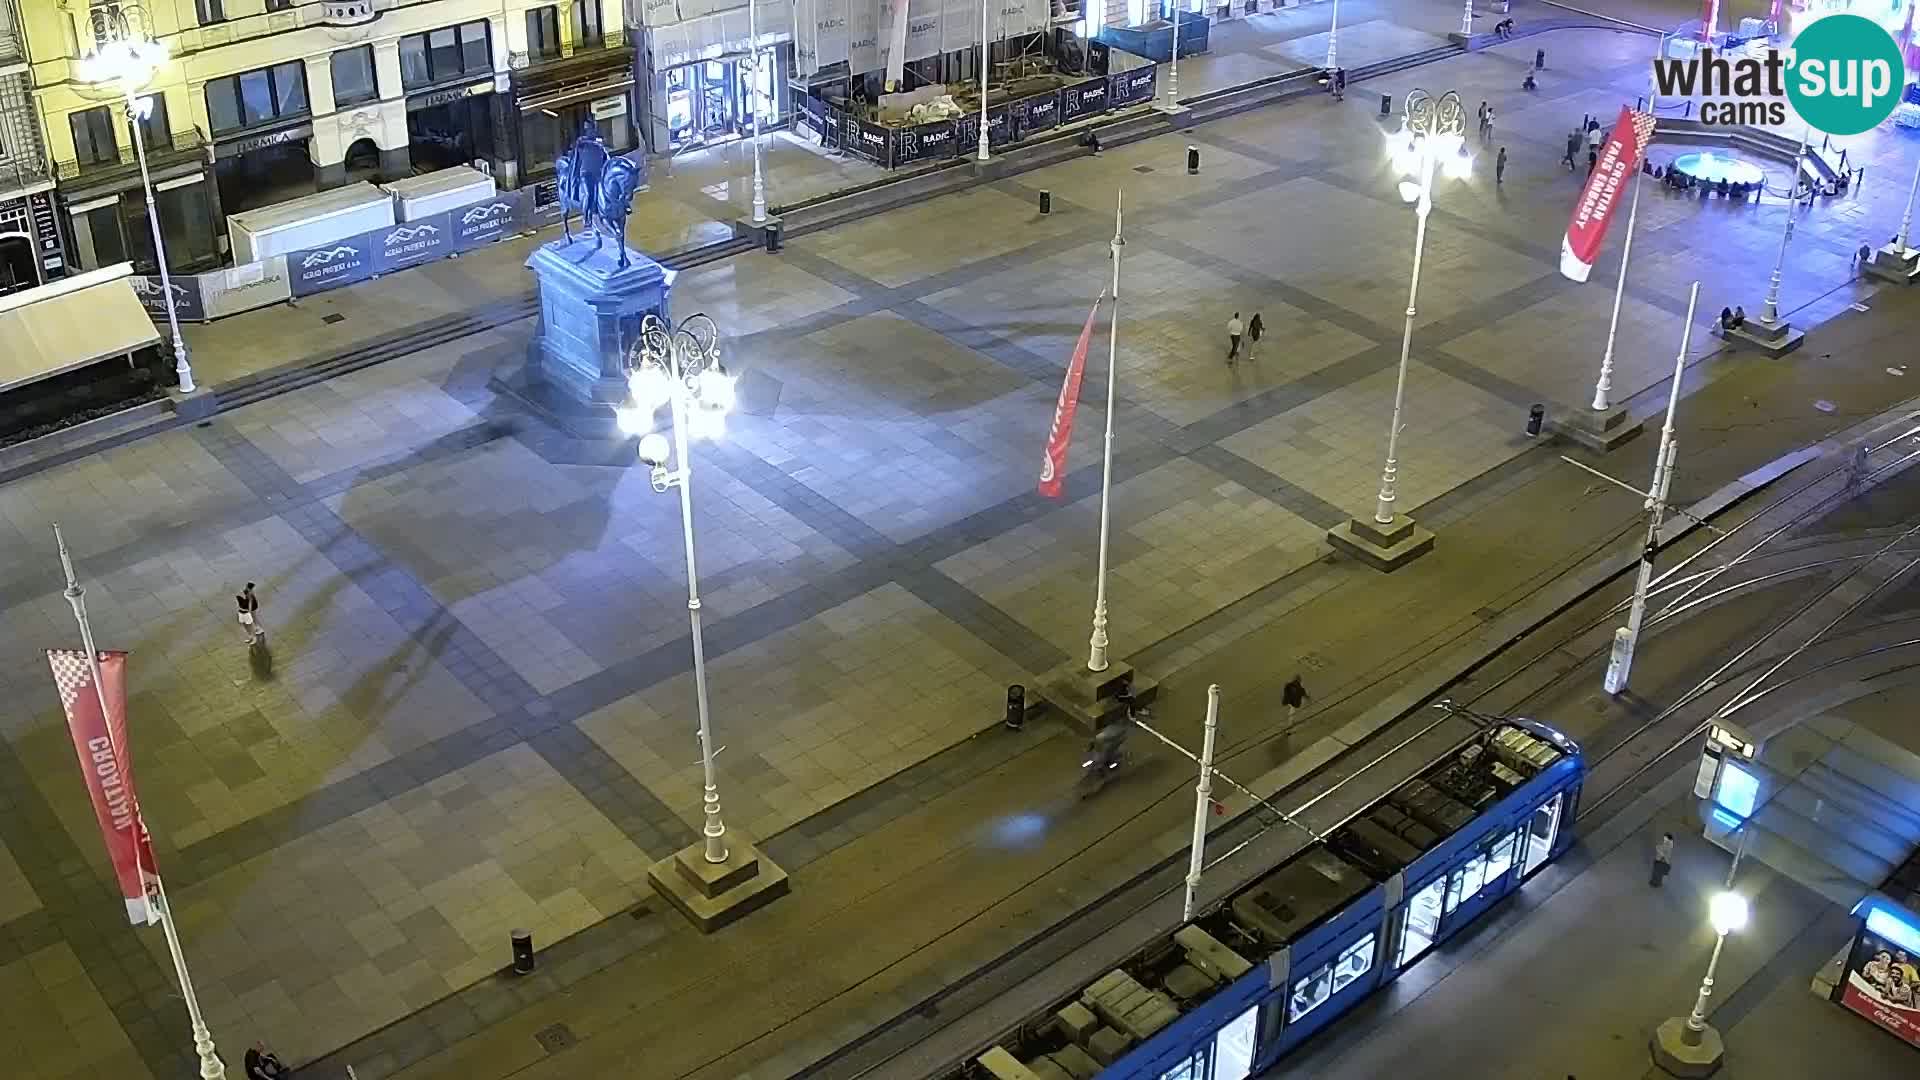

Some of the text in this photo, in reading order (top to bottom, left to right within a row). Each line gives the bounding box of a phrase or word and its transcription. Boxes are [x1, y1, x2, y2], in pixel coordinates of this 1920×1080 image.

[1575, 140, 1623, 230] FANS EMBASSY
[1592, 161, 1626, 221] CROATIAN
